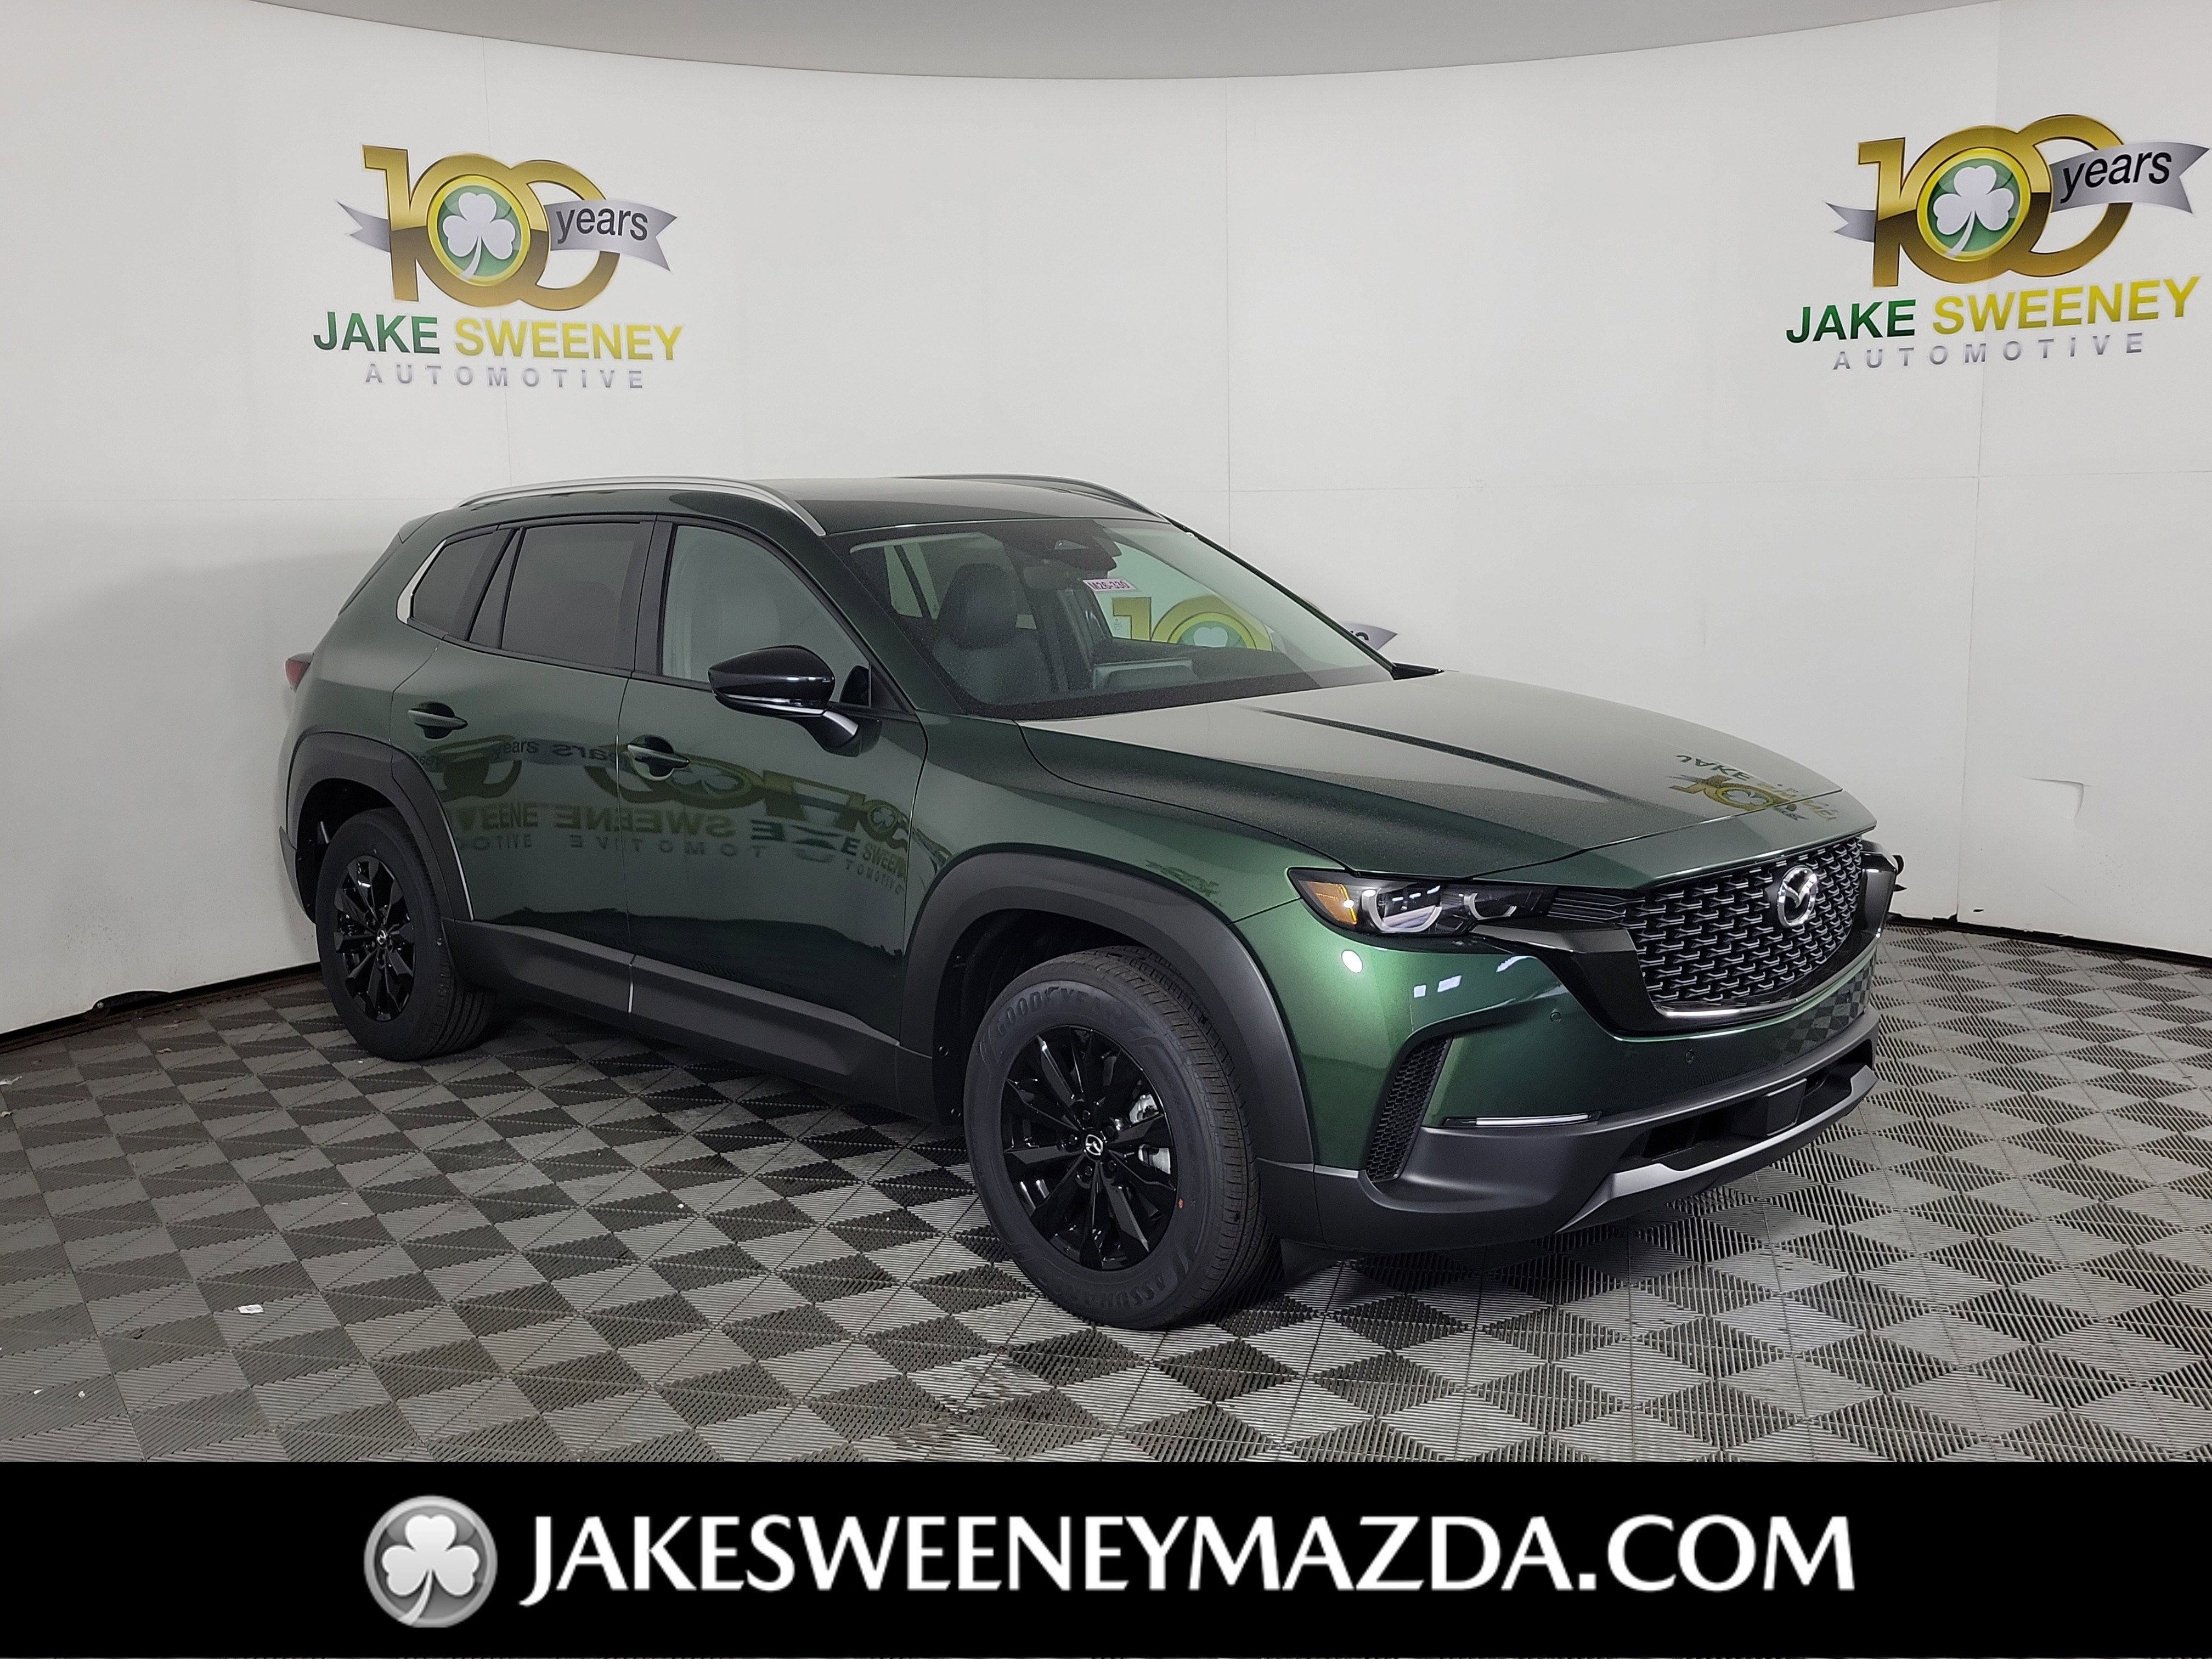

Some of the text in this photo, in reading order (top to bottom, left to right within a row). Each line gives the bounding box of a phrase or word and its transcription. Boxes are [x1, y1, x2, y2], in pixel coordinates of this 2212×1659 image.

[362, 144, 648, 311] 100 years
[1858, 114, 2172, 289] 100 years
[313, 311, 683, 361] JAKE SWEENEY
[1786, 276, 2201, 343] JAKE SWEENEY
[365, 363, 643, 388] AUTOMOTIVE
[1833, 332, 2143, 371] AUTOMOTIVE
